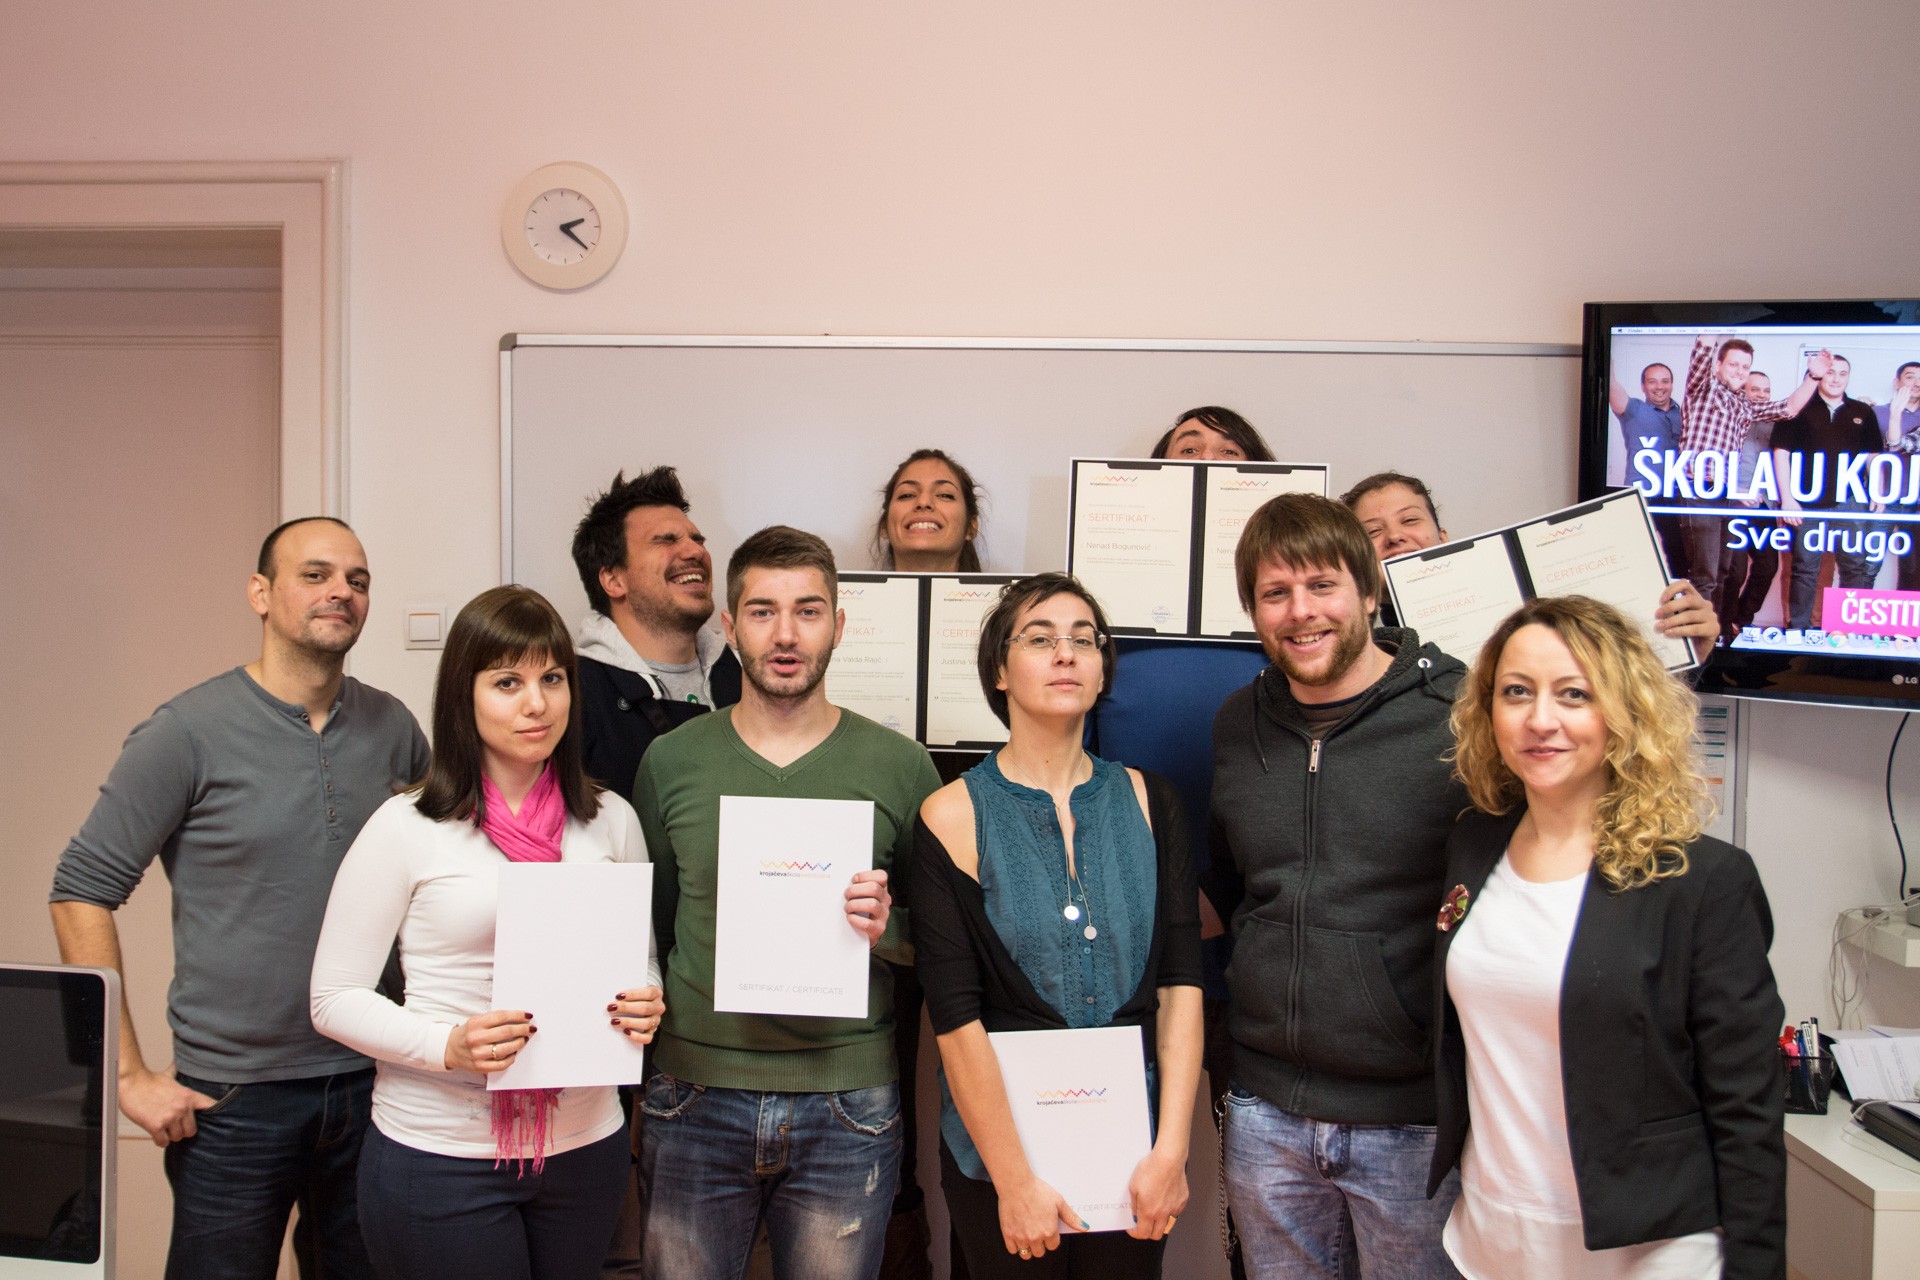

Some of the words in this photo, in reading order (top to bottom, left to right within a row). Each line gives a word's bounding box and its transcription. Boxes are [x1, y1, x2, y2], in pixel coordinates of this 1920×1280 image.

[1632, 436, 1780, 502] ŠKOLA
[1790, 451, 1825, 503] U
[1835, 452, 1920, 506] KOJ
[1088, 512, 1150, 523] SERTIFIKAT
[1726, 518, 1791, 550] Sve
[1803, 521, 1912, 562] drugo
[1086, 542, 1110, 550] Nenad
[1112, 542, 1152, 552] Bogunović
[1546, 554, 1618, 583] CERTIFICATE
[1416, 594, 1477, 619] SERTIFIKAT
[1841, 590, 1920, 627] ČESTIT
[843, 627, 877, 637] IFIKAT
[942, 628, 980, 638] CERTIF
[941, 658, 966, 666] Justina
[1905, 676, 1919, 684] LG
[738, 983, 784, 992] SERTIFIKAT
[792, 985, 844, 995] CERTIFICATE
